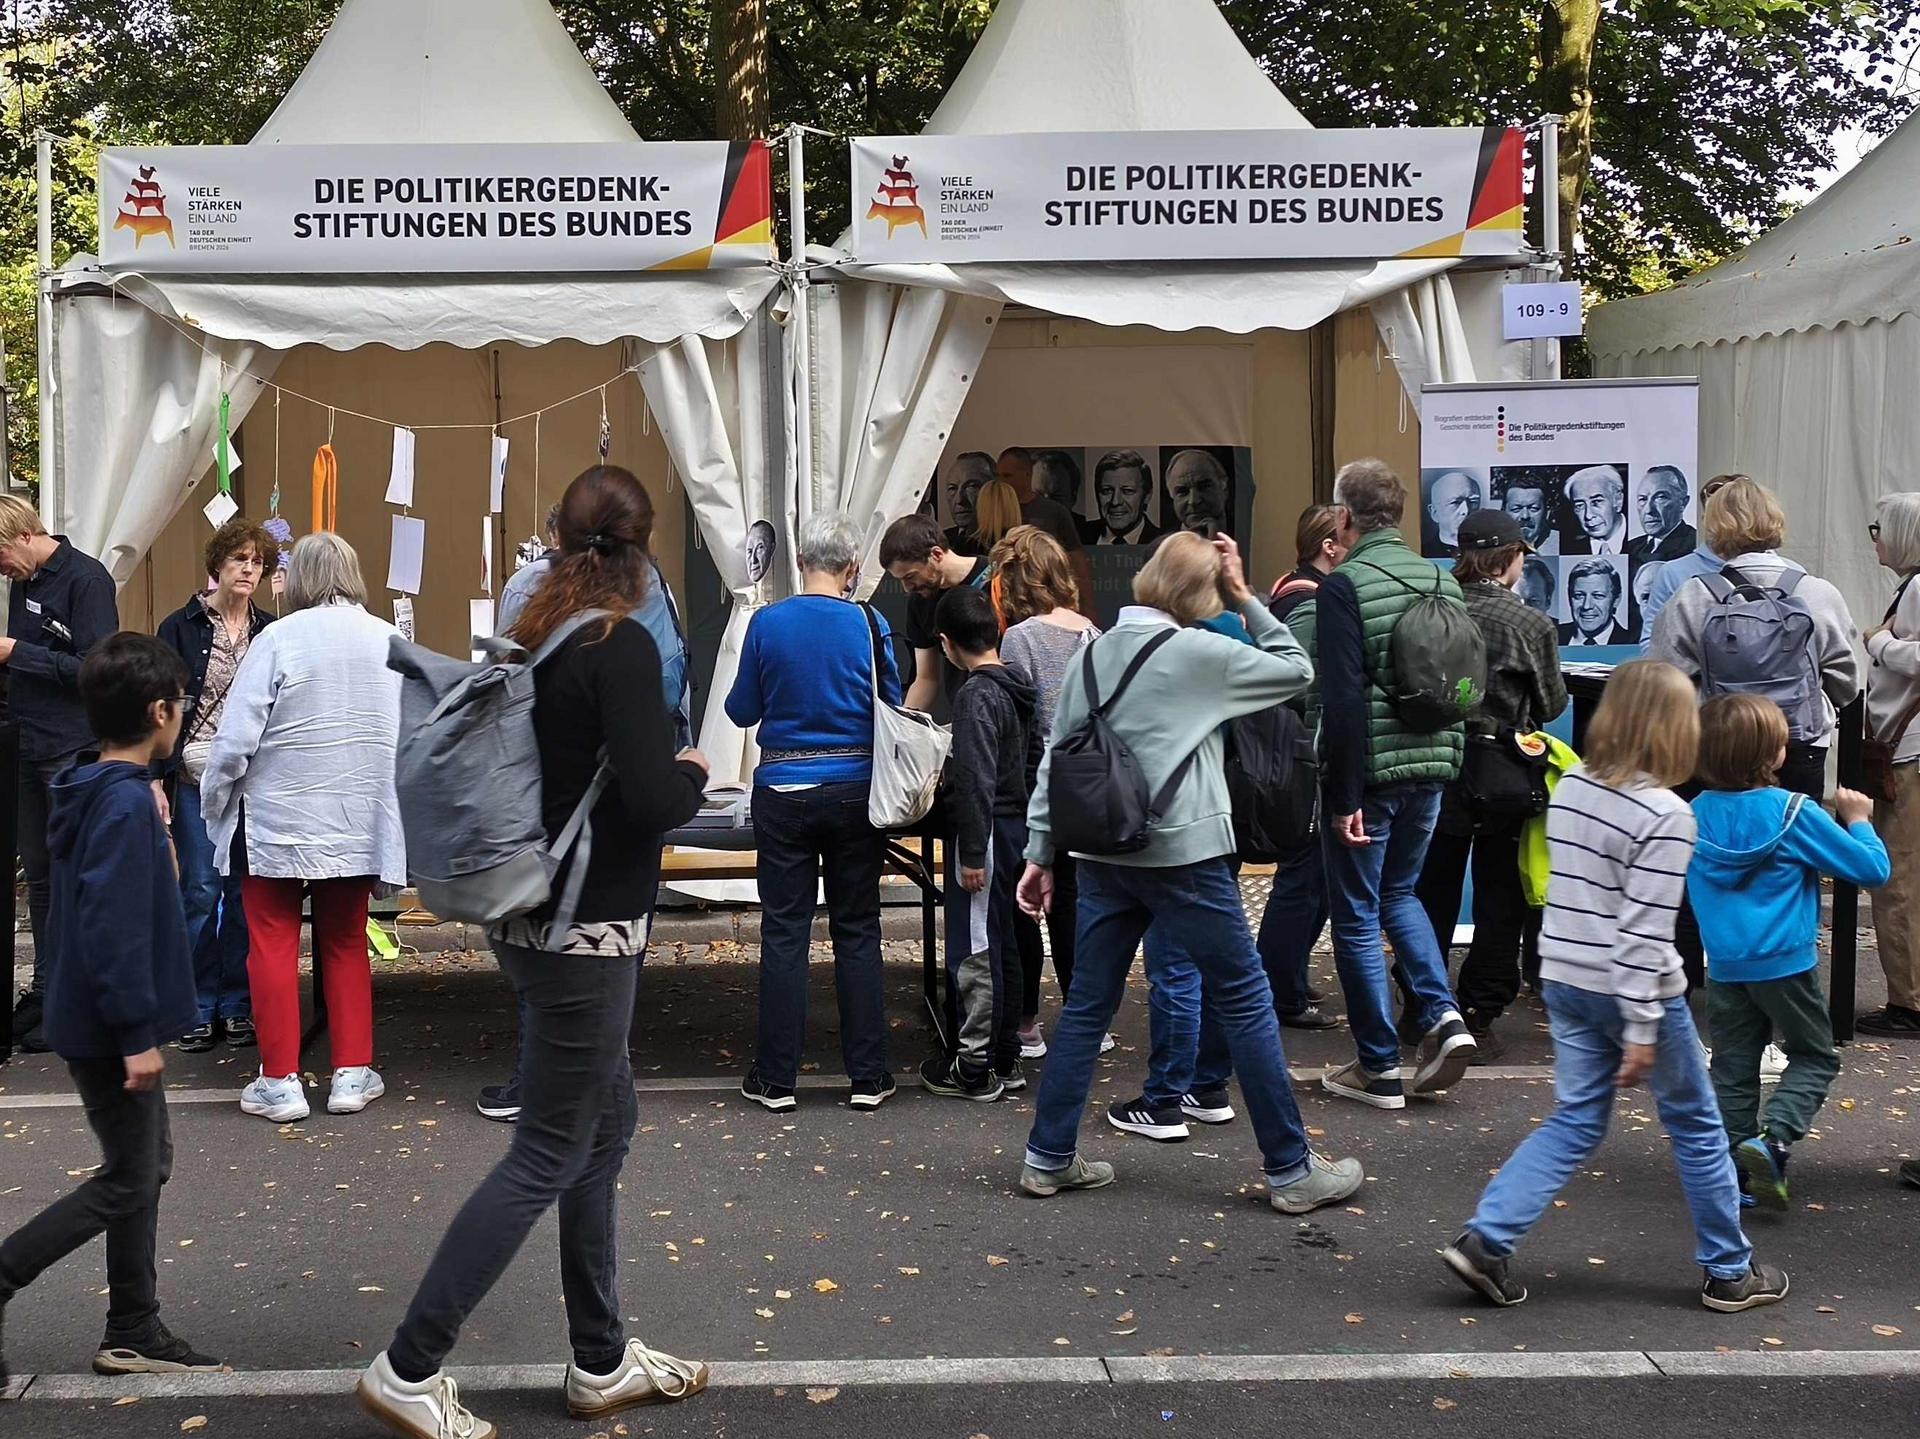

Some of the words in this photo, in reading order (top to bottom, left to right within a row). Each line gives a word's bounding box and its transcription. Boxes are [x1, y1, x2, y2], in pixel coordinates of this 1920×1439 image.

[940, 176, 973, 187] VIELE
[1066, 166, 1116, 191] DIE
[1126, 163, 1423, 190] POLITIKERGEDENK-
[188, 187, 221, 197] VIELE
[314, 178, 364, 204] DIE
[374, 176, 671, 203] POLITIKERGEDENK-
[940, 188, 994, 201] STÄRKEN
[188, 199, 242, 211] STÄRKEN
[941, 203, 958, 213] EIN
[960, 203, 989, 213] LAND
[1044, 199, 1238, 226] STIFTUNGEN
[1249, 198, 1307, 224] DES
[1318, 197, 1443, 224] BUNDES
[188, 213, 206, 224] EIN
[208, 213, 238, 224] LAND
[293, 212, 487, 238] STIFTUNGEN
[499, 211, 557, 238] DES
[567, 210, 692, 237] BUNDES
[941, 226, 978, 234] DEUTSCHEN
[1517, 303, 1545, 318] 109
[1559, 302, 1569, 316] 9
[1508, 424, 1522, 432] Die
[1523, 421, 1626, 432] Politikergedenkstiftungen
[1508, 433, 1524, 442] des
[1525, 432, 1555, 441] Bundes
